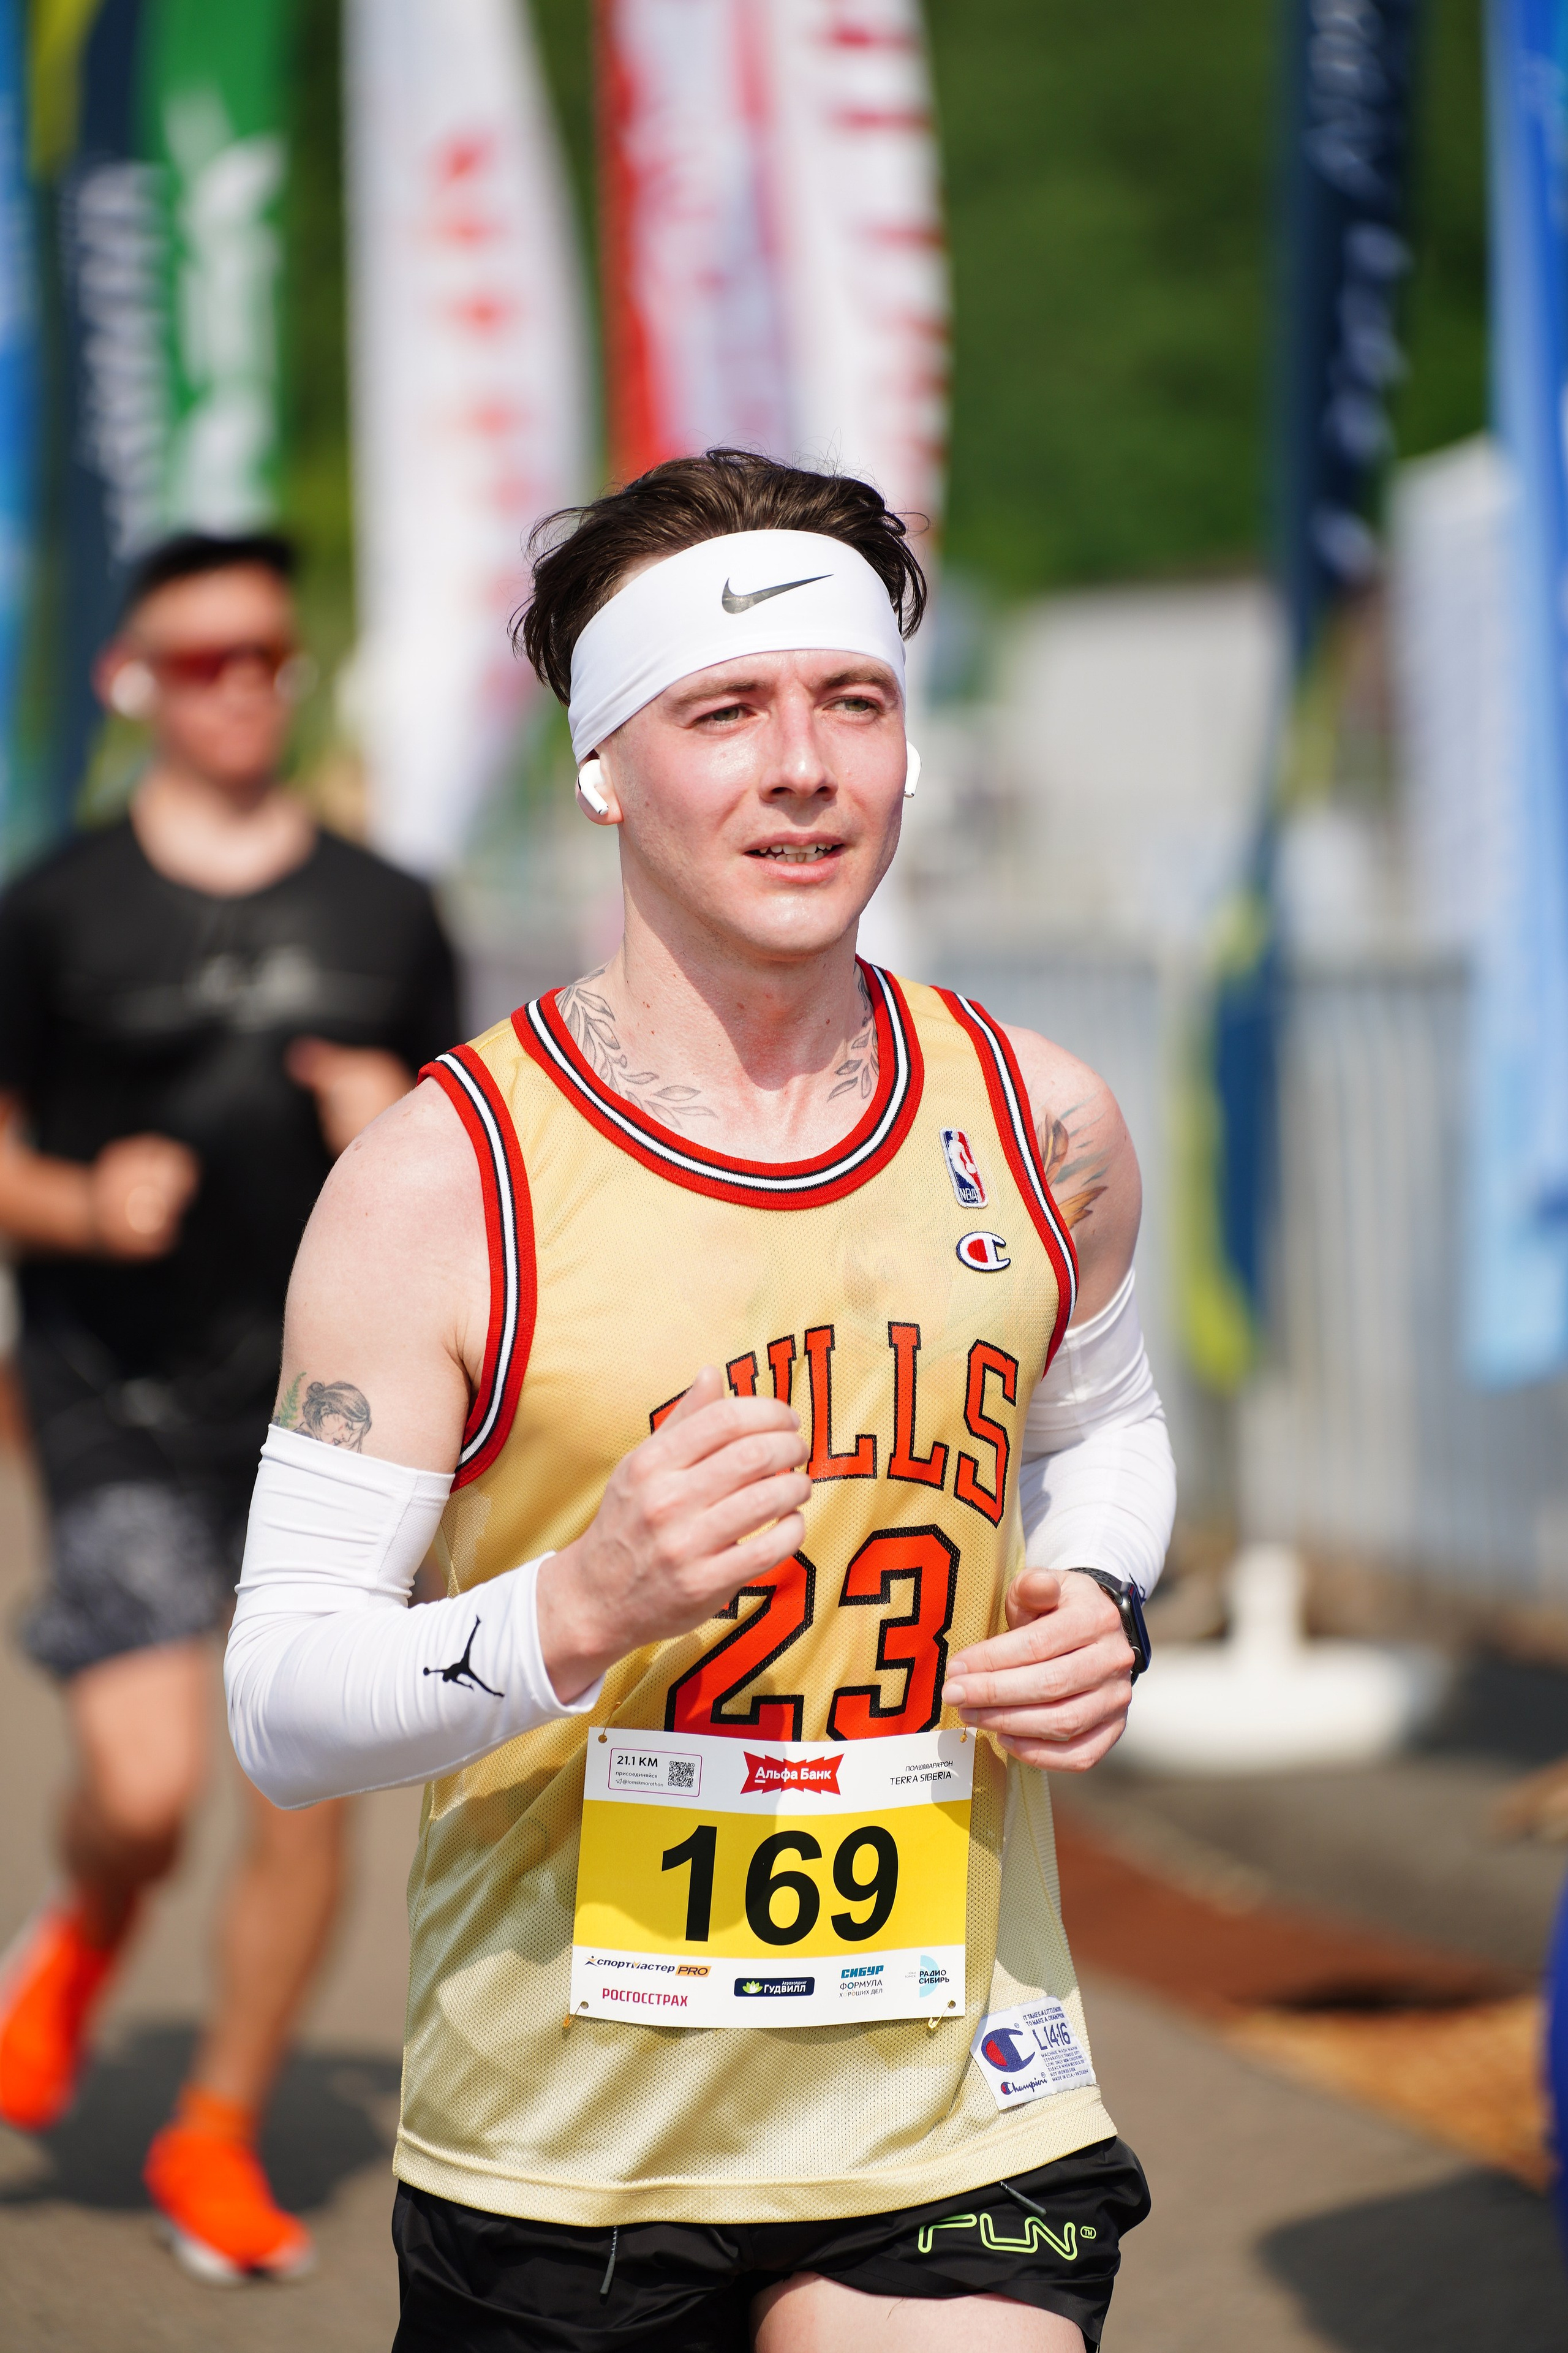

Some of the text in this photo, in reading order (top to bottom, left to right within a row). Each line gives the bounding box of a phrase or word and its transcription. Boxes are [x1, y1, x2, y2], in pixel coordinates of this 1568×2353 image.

[959, 1188, 978, 1201] NBA
[650, 1321, 1019, 1528] ULLS
[664, 1524, 960, 1743] 23
[617, 1756, 635, 1766] 21.1
[905, 1761, 953, 1772] ПОЛУМАРАФОН
[755, 1766, 832, 1783] Альфа Банк
[890, 1771, 951, 1785] TERRA SIBERIA
[662, 1825, 899, 1946] 169
[677, 1966, 708, 1976] PRO
[841, 1965, 884, 1979] СИБУР
[840, 1979, 883, 1990] ФОРМУЛА
[602, 1988, 688, 2007] РОСГОССТРАХ
[839, 1989, 870, 1998] ХОРОШИХ
[1032, 2029, 1047, 2050] L
